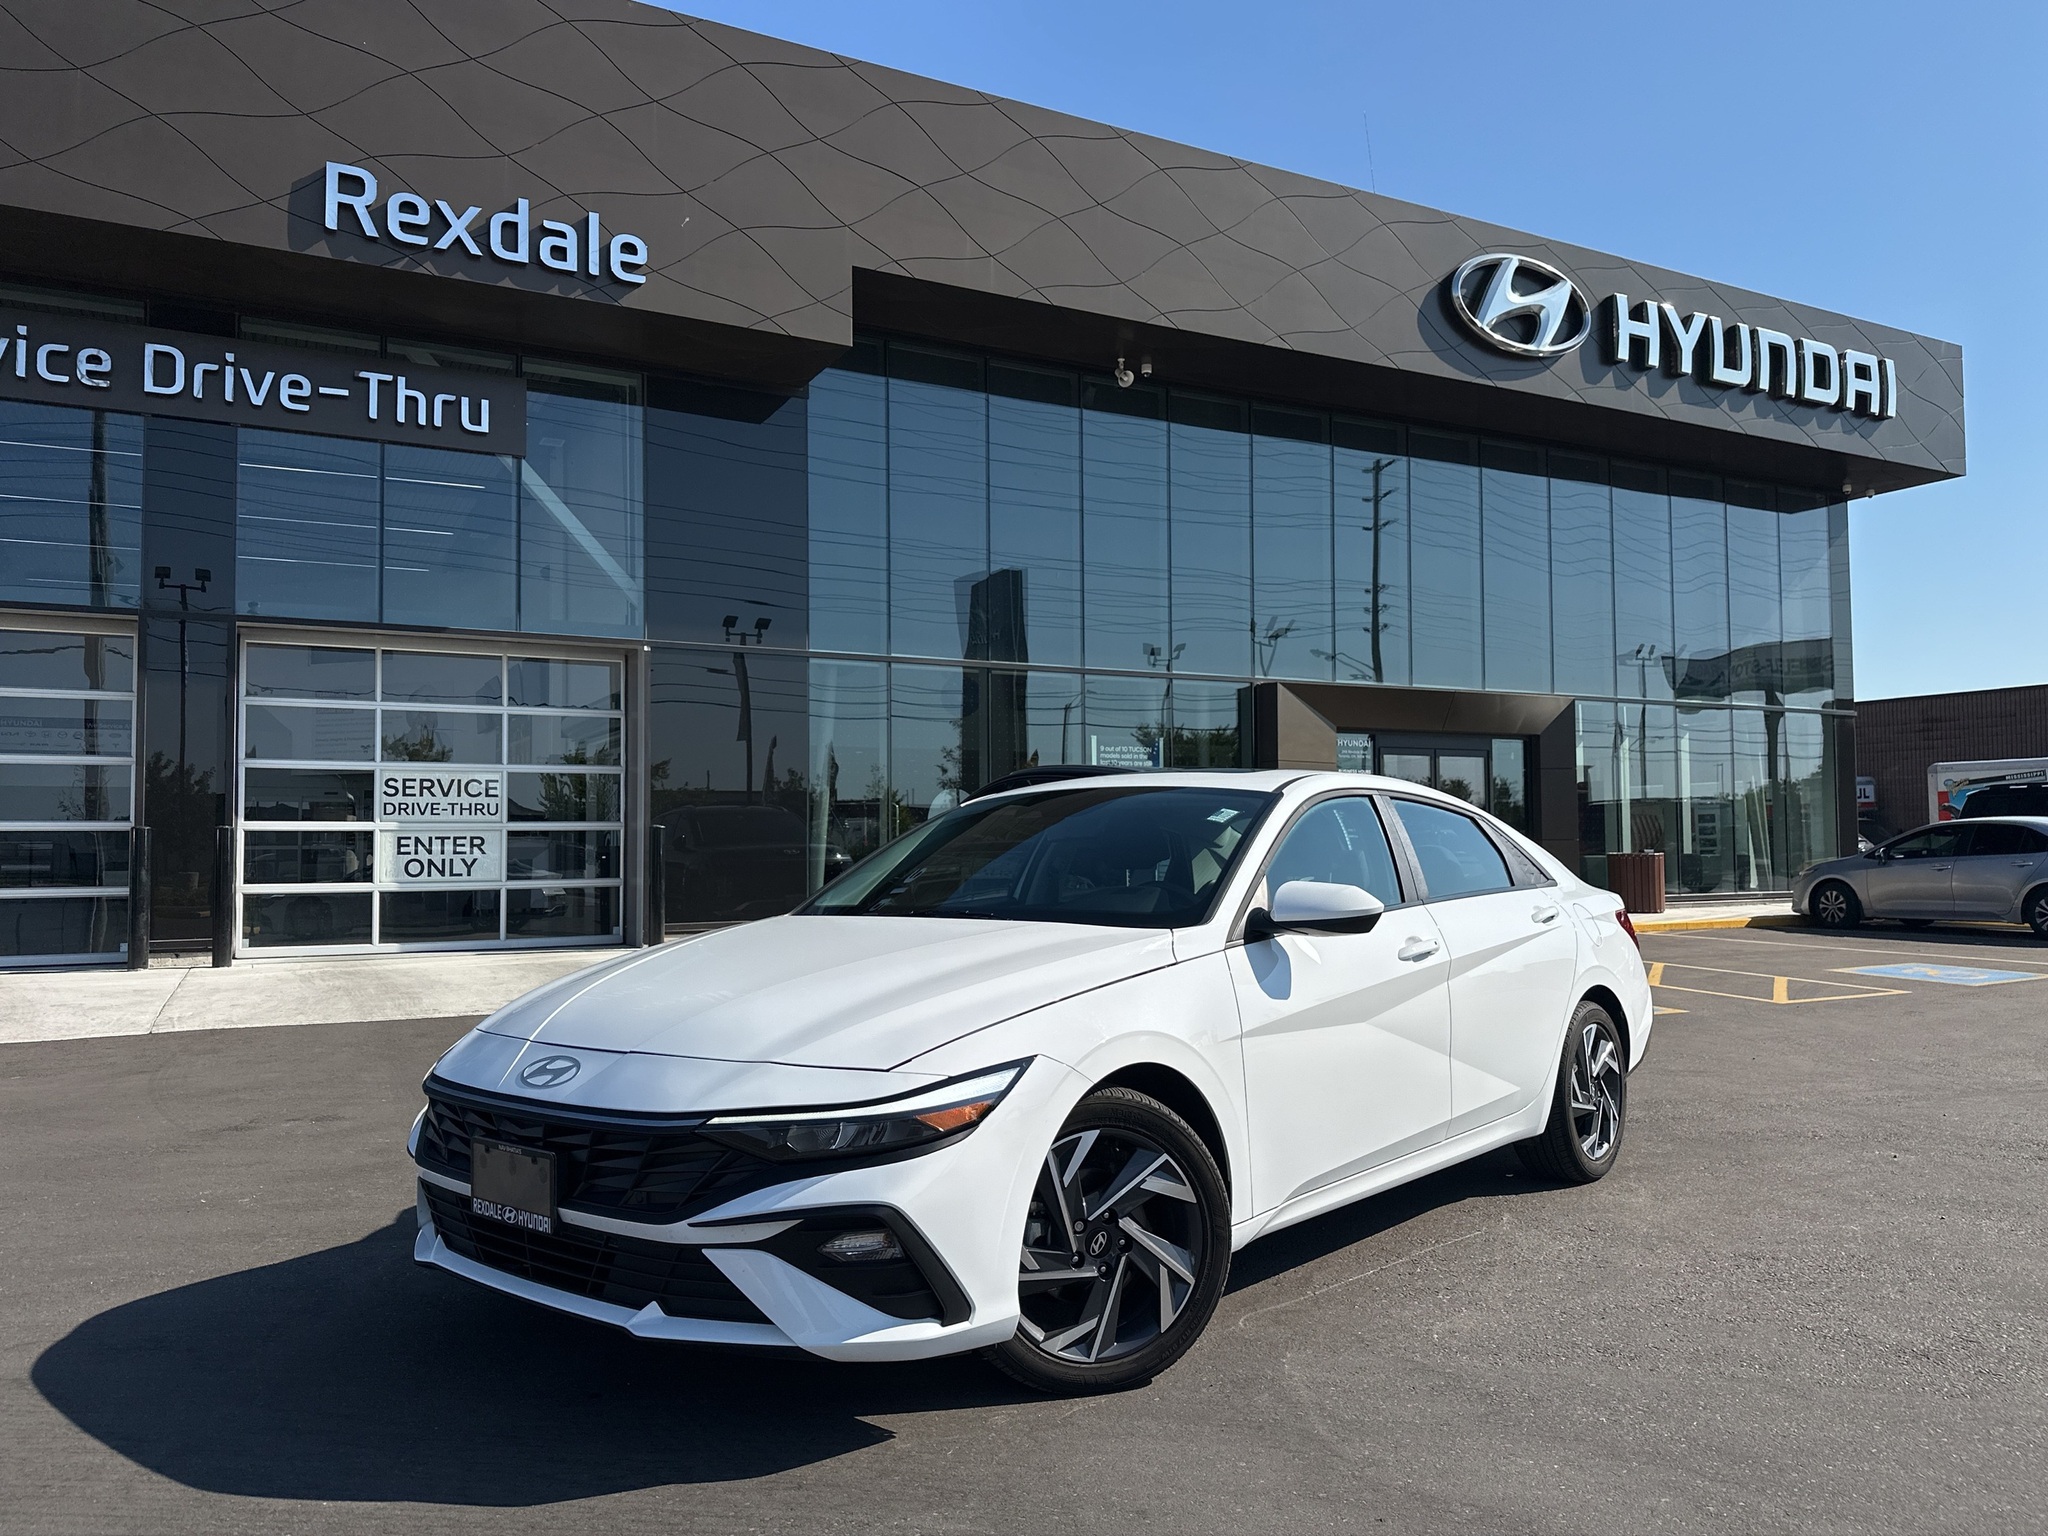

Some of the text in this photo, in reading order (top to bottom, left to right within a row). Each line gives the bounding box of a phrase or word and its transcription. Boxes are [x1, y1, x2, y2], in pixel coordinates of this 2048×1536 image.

[325, 161, 648, 284] Rexdale
[1613, 293, 1895, 419] HYUNDAI
[0, 325, 489, 434] ice Drive-Thru
[0, 719, 43, 728] HYUNDAI
[1337, 739, 1371, 747] HYUNDAI
[2005, 771, 2044, 781] MISSISSIPPI
[383, 777, 499, 799] SERVICE
[383, 801, 499, 817] DRIVE-THRU
[397, 836, 486, 857] ENTER
[403, 858, 479, 879] ONLY
[473, 1197, 551, 1234] REXDALE HYUNDAI
